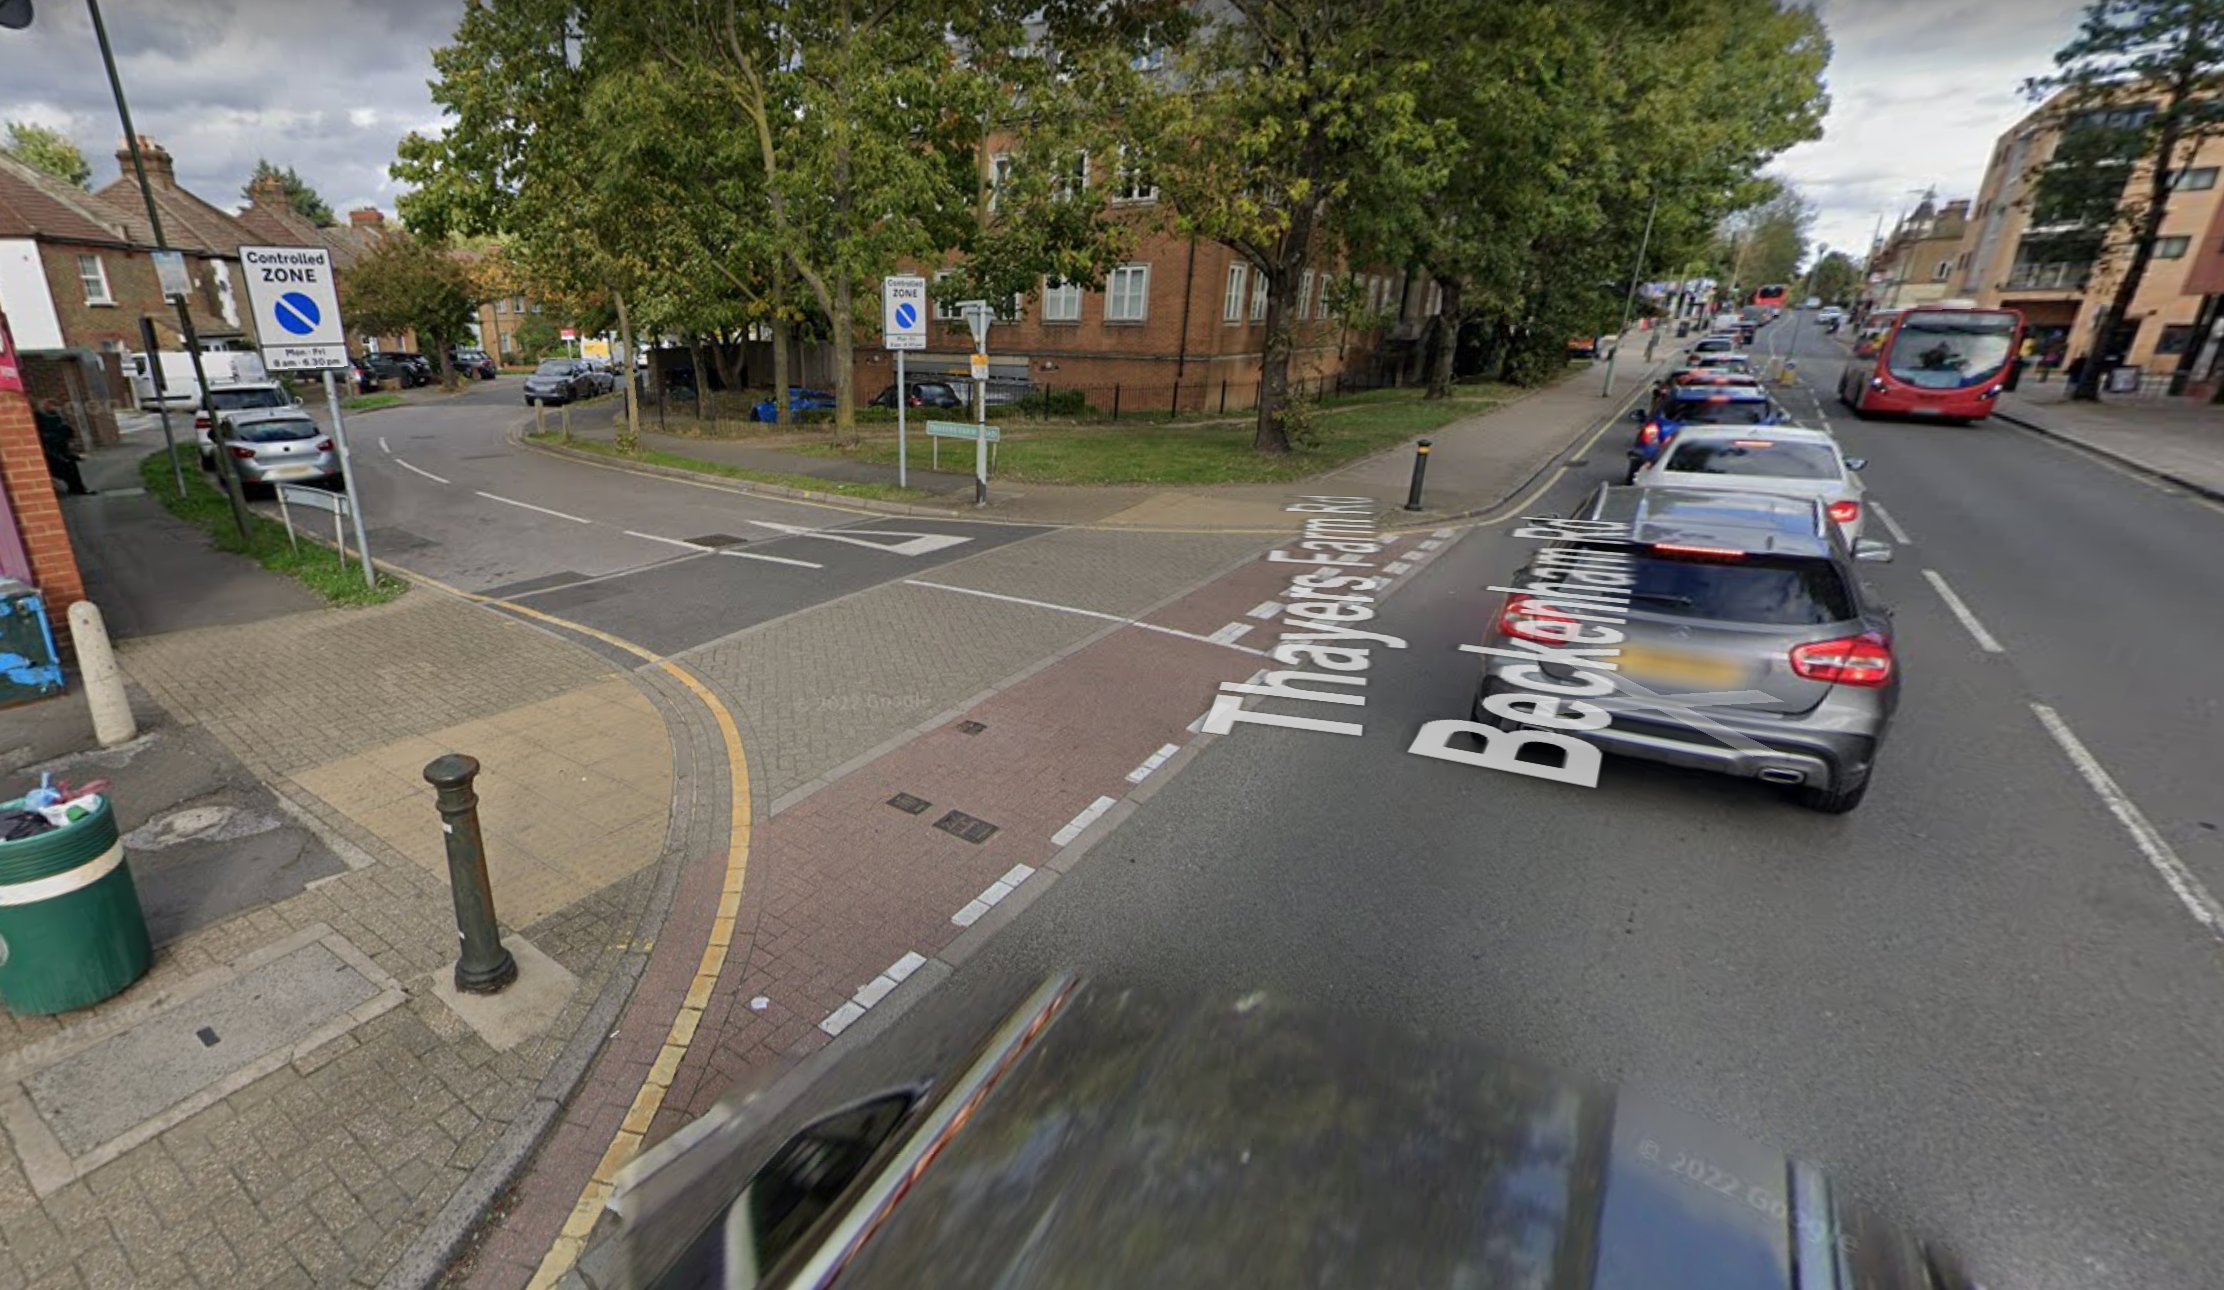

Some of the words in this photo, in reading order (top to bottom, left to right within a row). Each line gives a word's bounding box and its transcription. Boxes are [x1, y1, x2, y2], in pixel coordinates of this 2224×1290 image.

[247, 251, 325, 266] Controlled
[262, 268, 317, 282] ZONE
[887, 279, 924, 288] Controlled
[892, 289, 918, 298] ZONE
